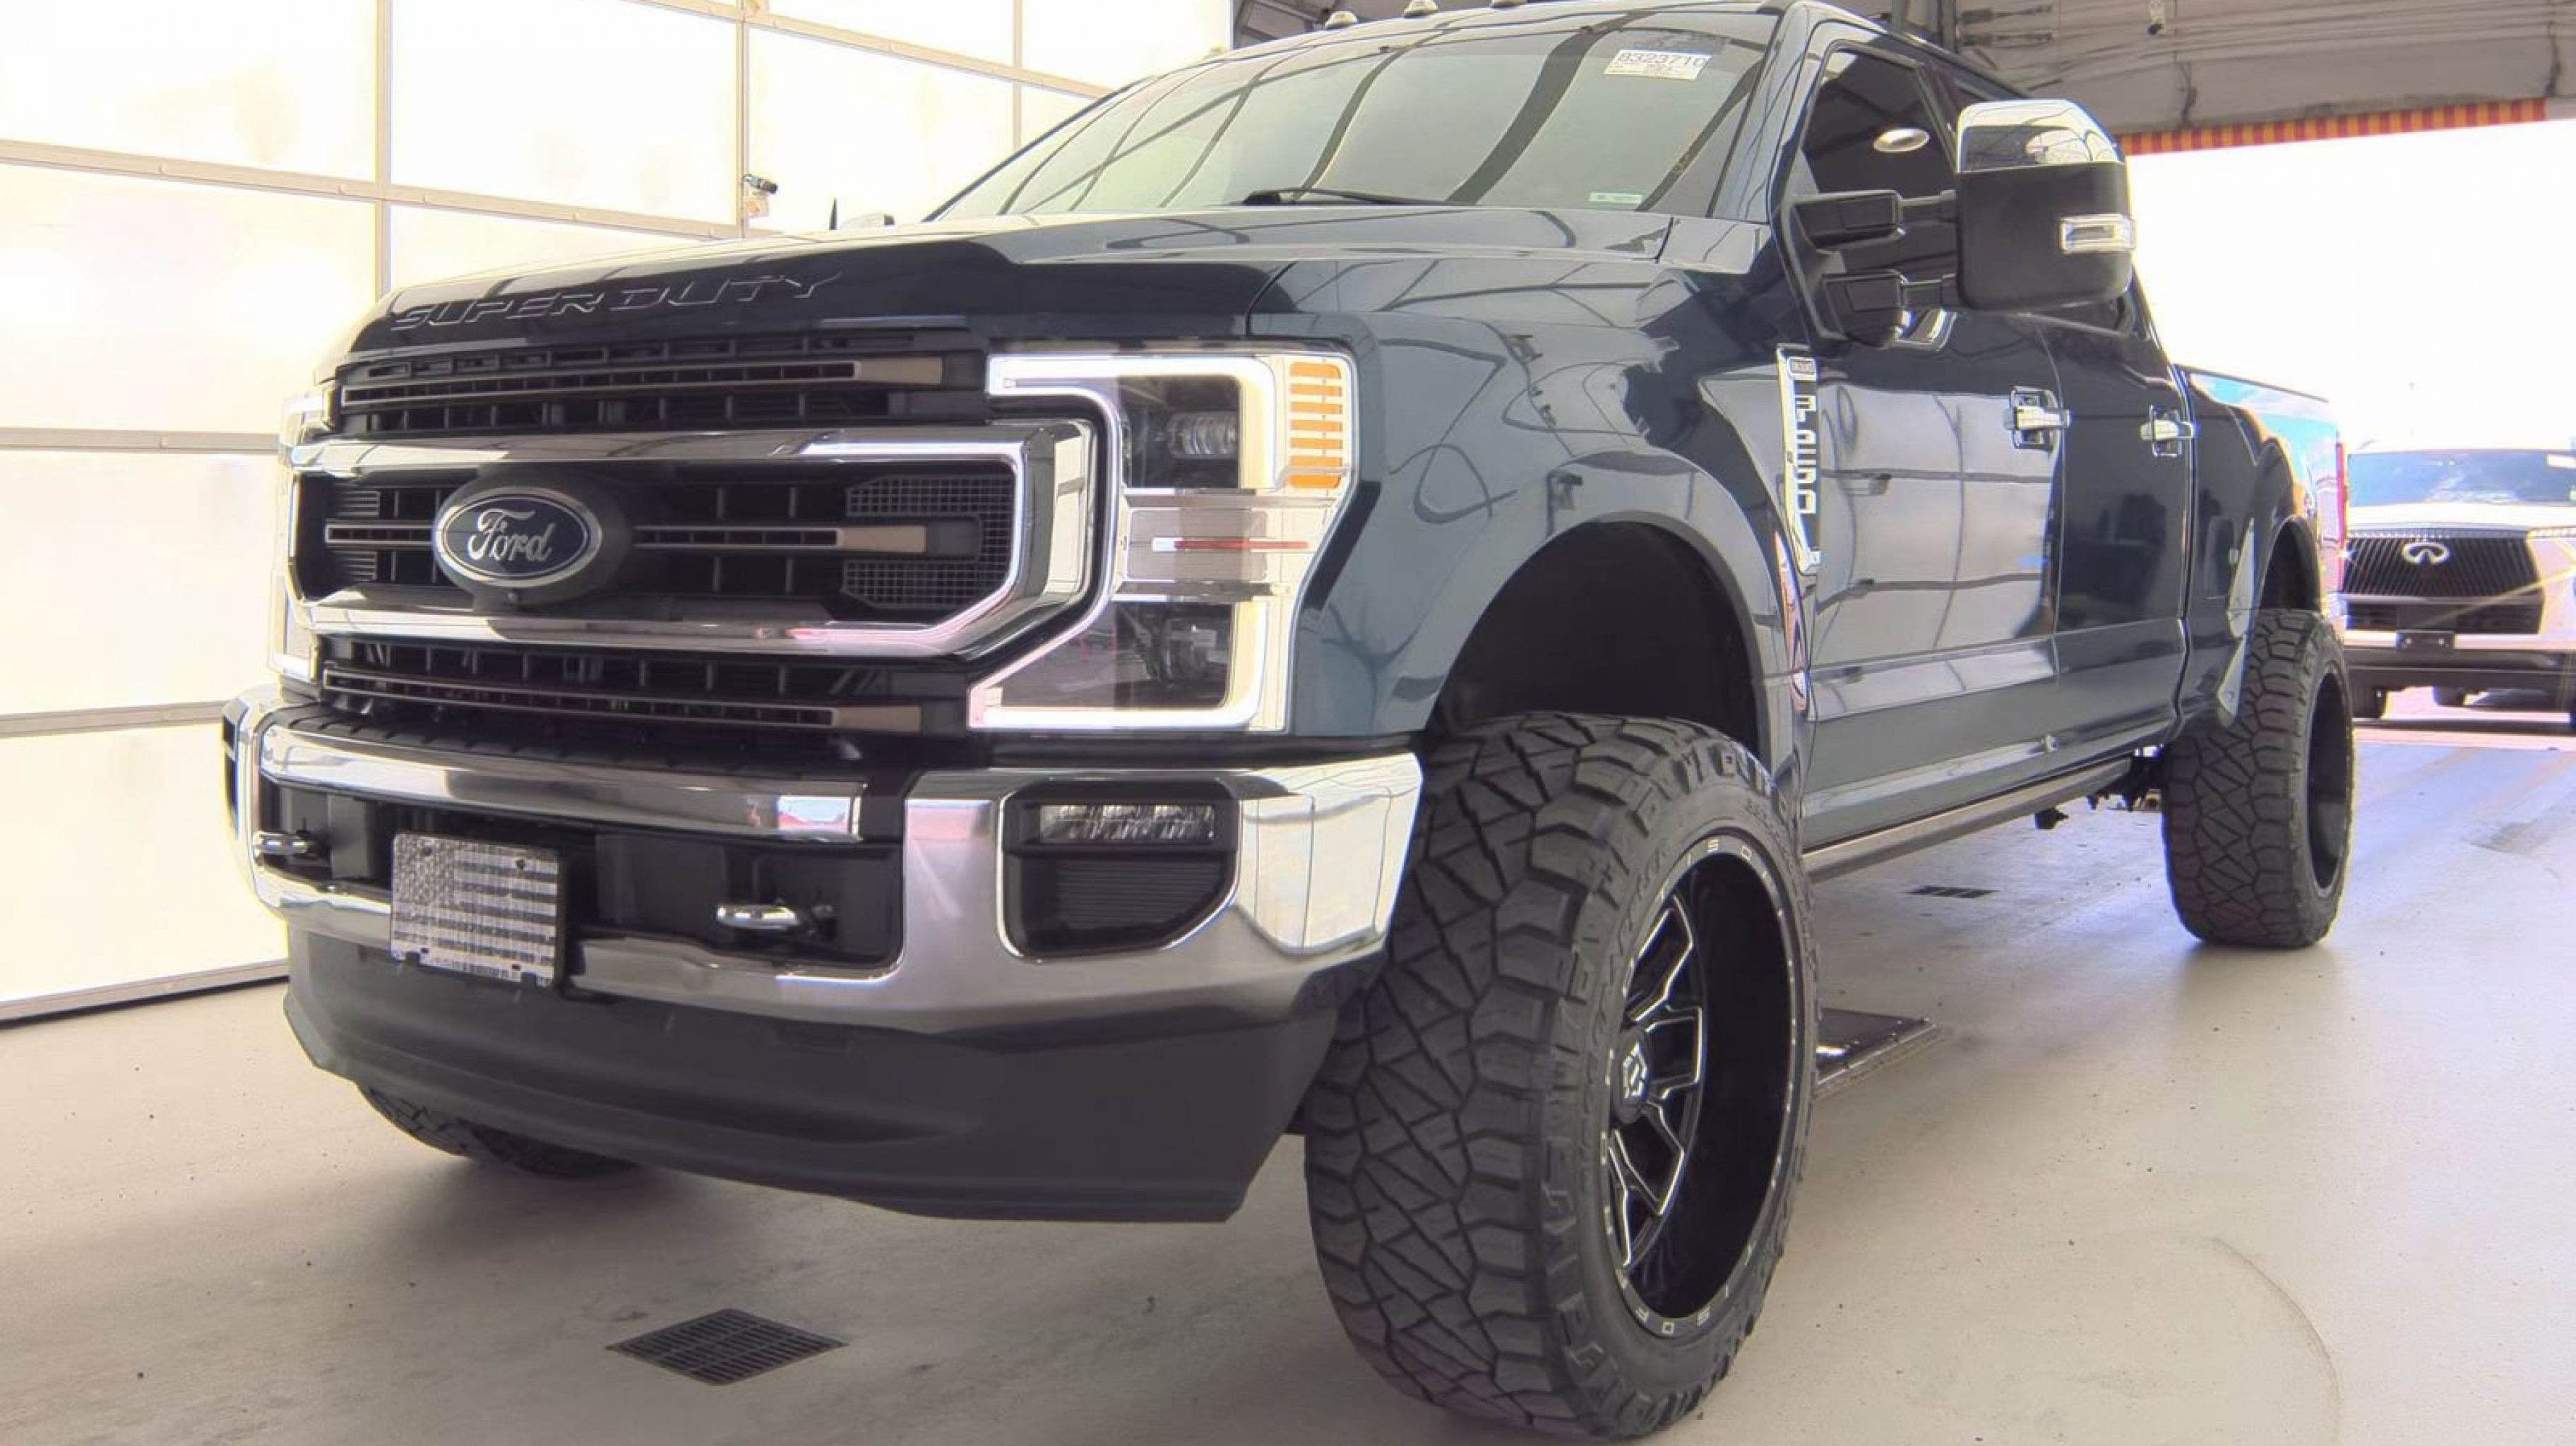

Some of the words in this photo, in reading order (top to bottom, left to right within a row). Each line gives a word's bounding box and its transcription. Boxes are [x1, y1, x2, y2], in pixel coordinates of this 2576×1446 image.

[1617, 52, 1707, 68] 8323710
[390, 292, 605, 331] SUPER
[609, 272, 843, 312] DUTY
[467, 508, 556, 562] Ford
